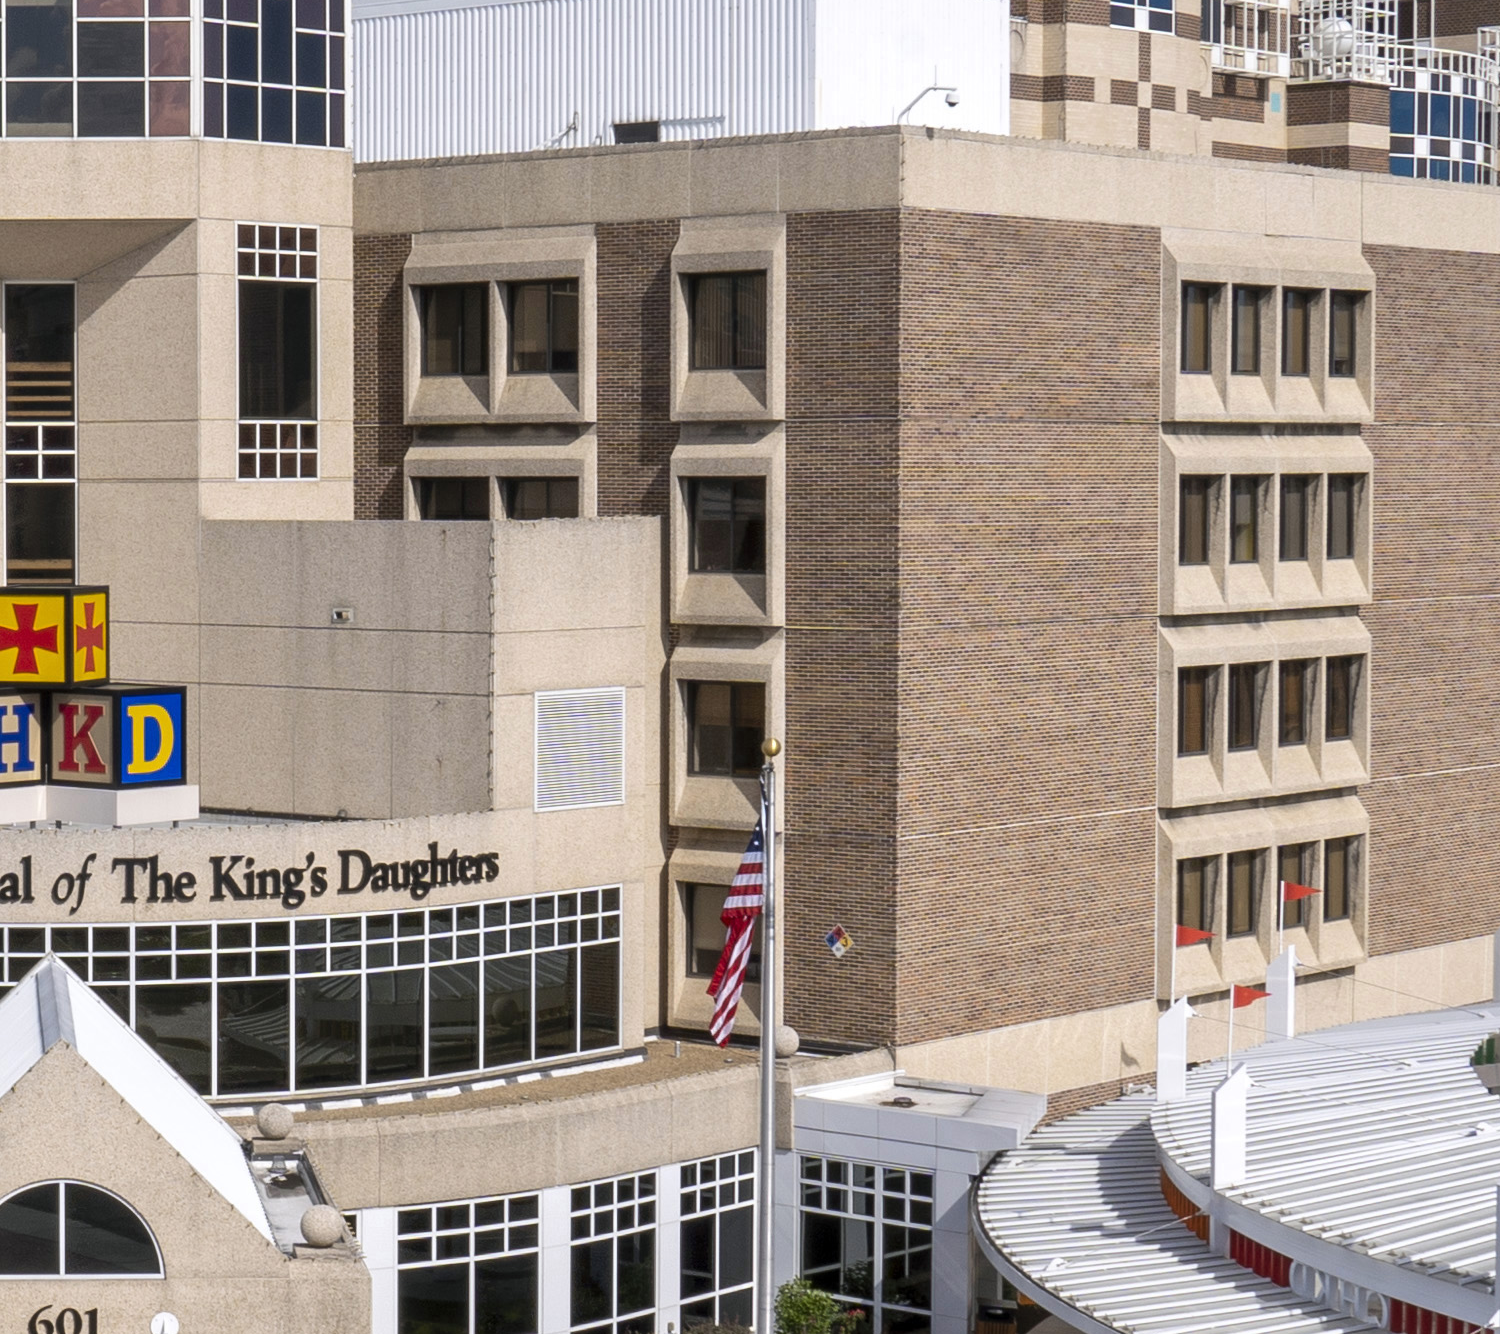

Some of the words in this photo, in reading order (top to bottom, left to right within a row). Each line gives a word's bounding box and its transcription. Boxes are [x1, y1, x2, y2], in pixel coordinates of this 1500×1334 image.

[51, 853, 96, 915] of
[112, 854, 197, 903] The
[209, 851, 328, 909] King's
[337, 841, 500, 900] Daughters
